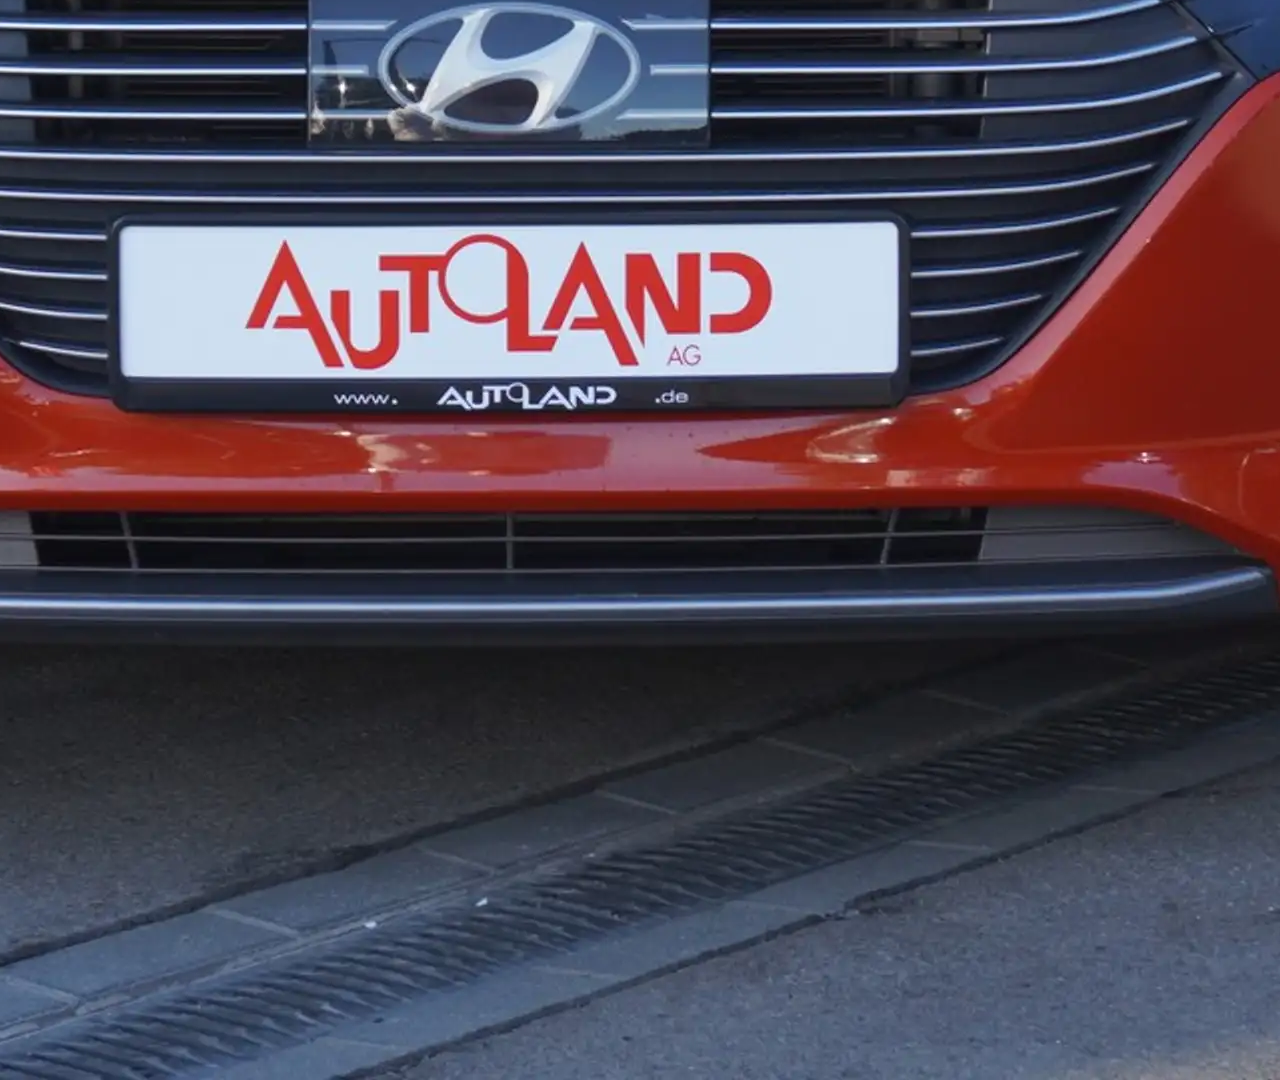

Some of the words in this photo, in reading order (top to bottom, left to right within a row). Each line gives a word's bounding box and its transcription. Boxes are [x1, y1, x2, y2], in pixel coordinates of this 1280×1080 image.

[245, 234, 773, 370] AUTOLAND
[666, 344, 702, 367] AG
[436, 381, 618, 411] AUTOLAND
